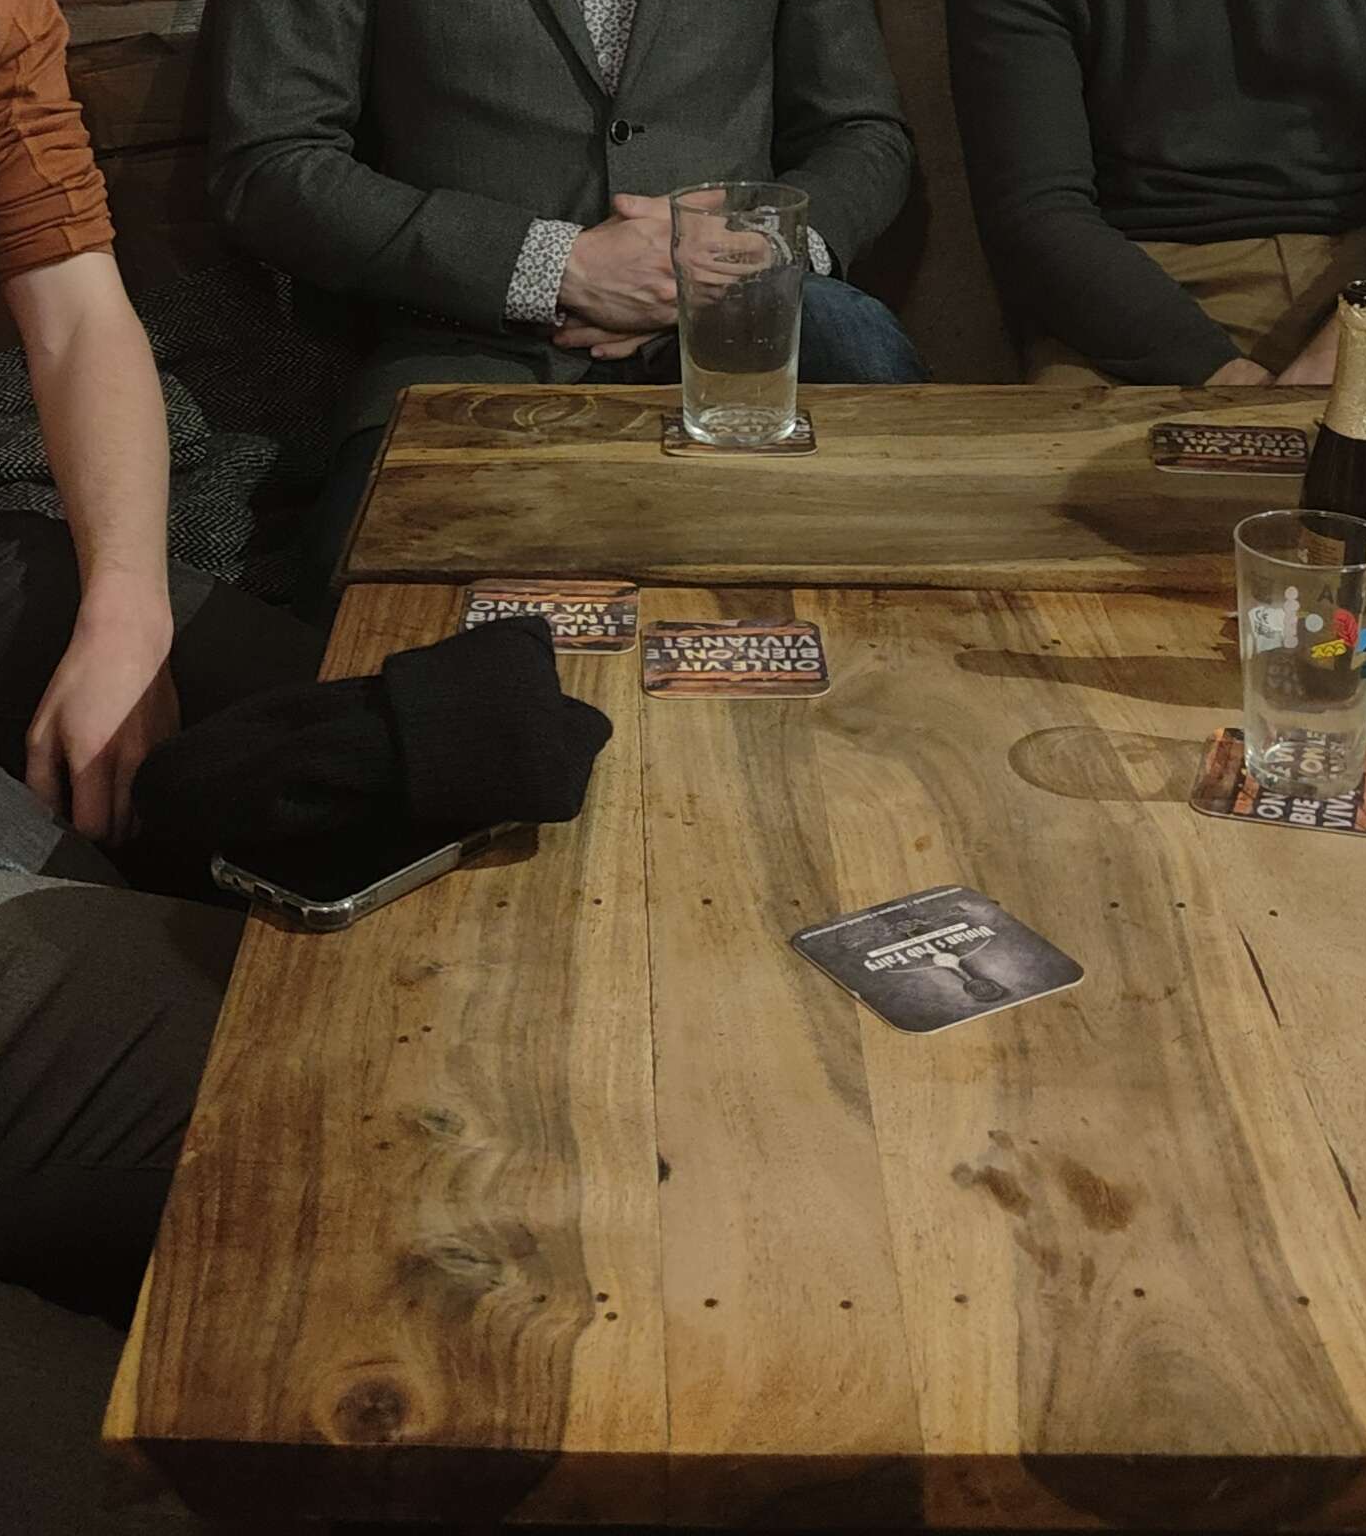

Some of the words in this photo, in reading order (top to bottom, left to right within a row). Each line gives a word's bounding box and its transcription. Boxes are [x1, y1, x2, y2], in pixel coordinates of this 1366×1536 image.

[471, 600, 520, 612] ON
[525, 602, 555, 612] LE
[562, 603, 608, 613] VIT
[551, 614, 598, 625] ON
[604, 615, 635, 625] LE
[646, 648, 680, 660] LE
[685, 648, 733, 660] ON
[677, 661, 726, 672] VIT
[733, 661, 763, 672] LE
[769, 660, 820, 671] ON
[906, 942, 940, 959] Pub
[864, 951, 910, 971] Fairy
